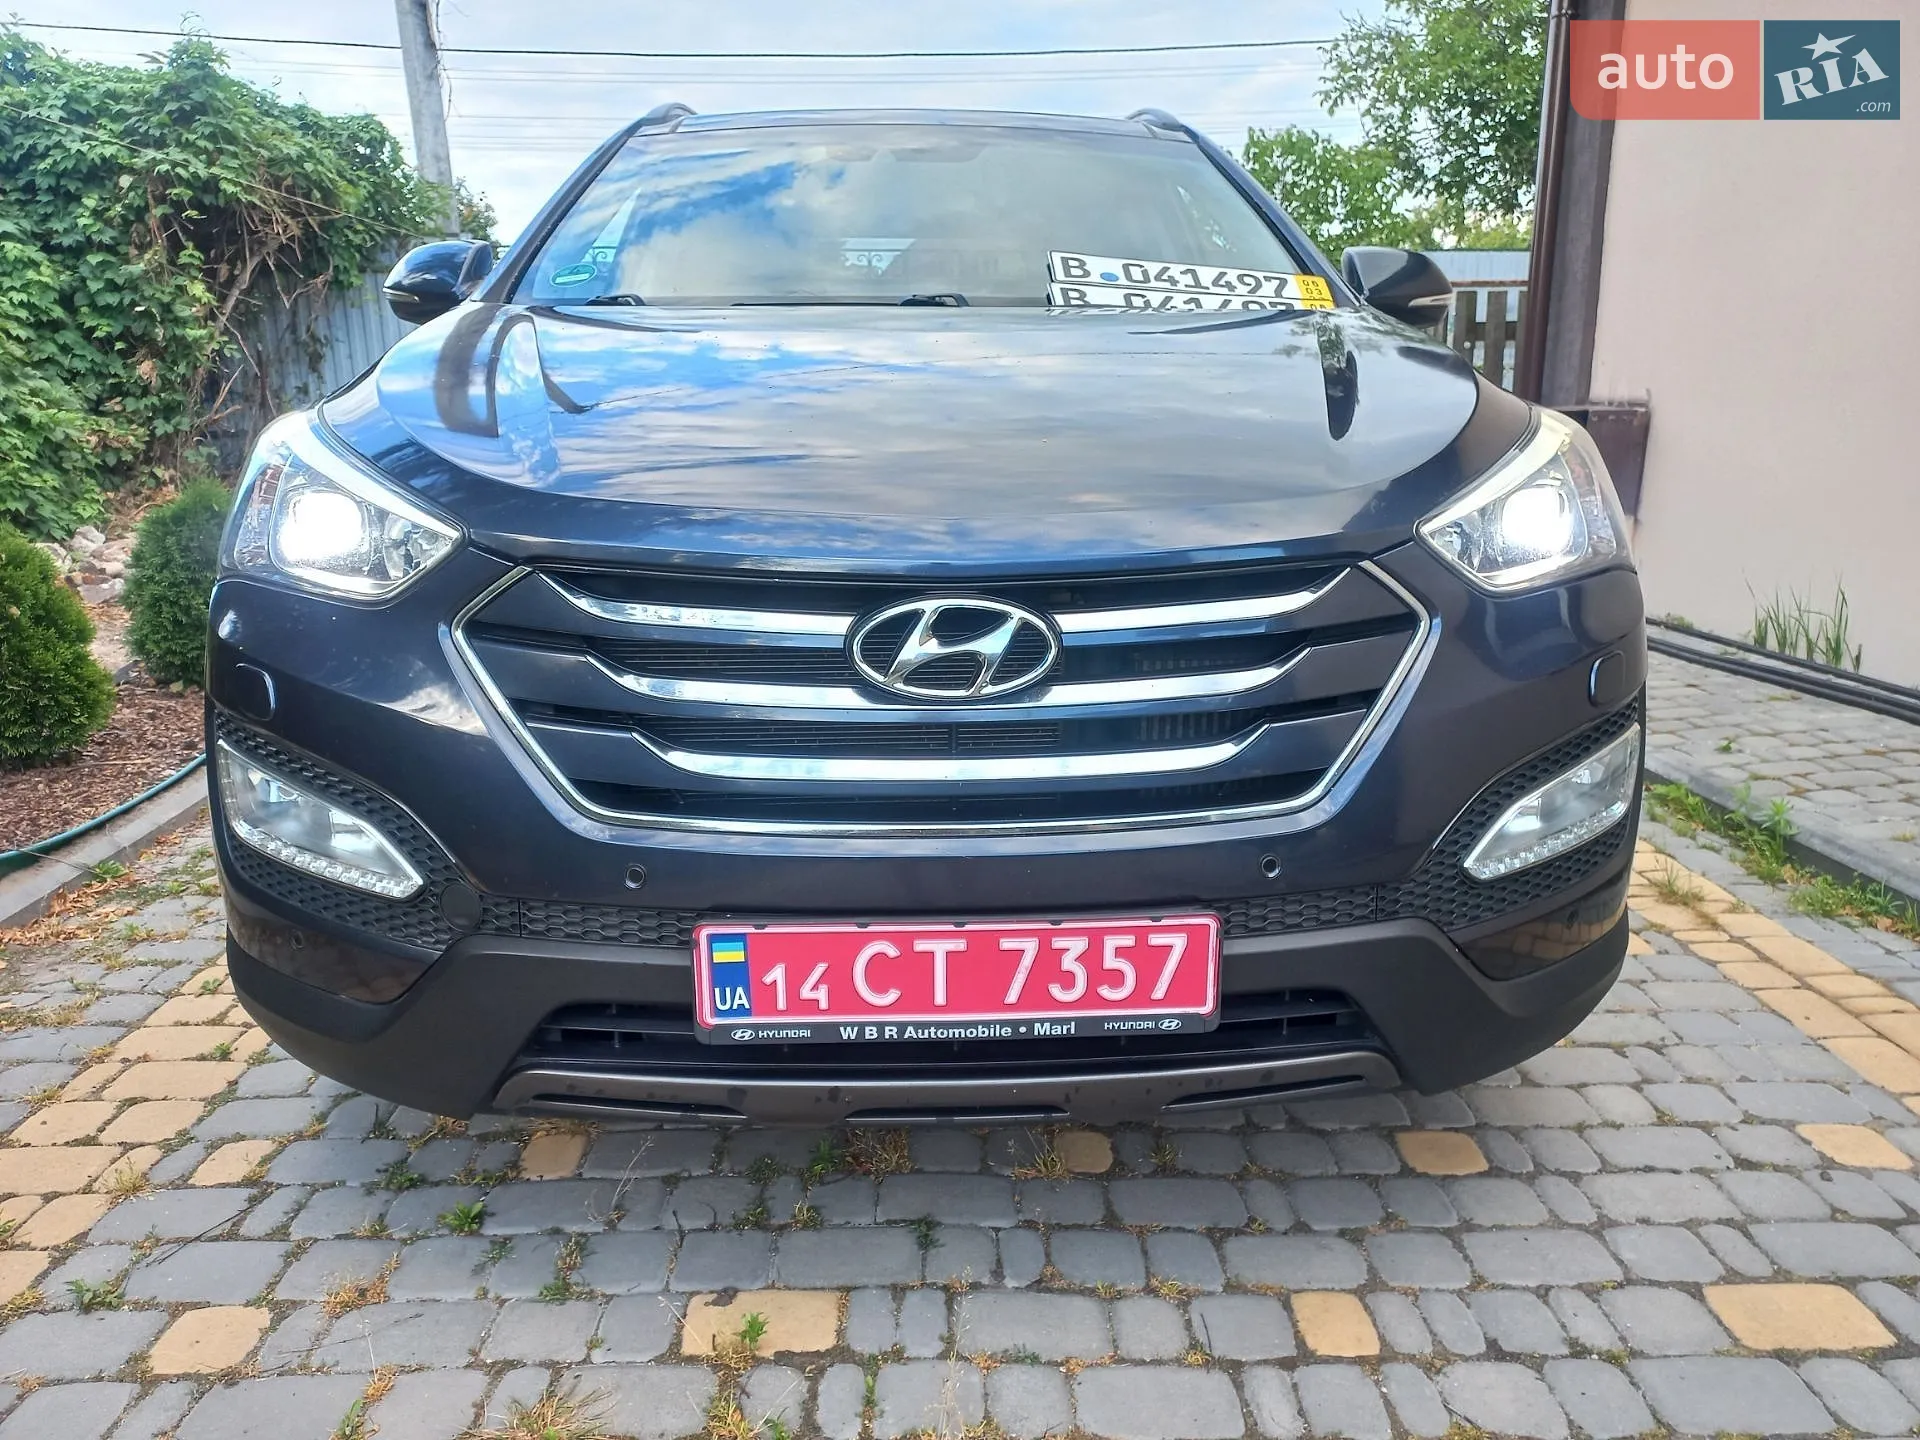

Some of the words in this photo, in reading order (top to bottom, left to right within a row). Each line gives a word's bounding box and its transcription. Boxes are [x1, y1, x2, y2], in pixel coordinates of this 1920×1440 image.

[1060, 256, 1092, 280] B
[1122, 262, 1289, 299] 041497
[761, 962, 830, 1011] 14
[851, 940, 968, 1008] CT
[999, 933, 1189, 1006] 7357
[713, 985, 751, 1011] UA
[757, 1028, 812, 1039] HYUNDAI
[839, 1026, 861, 1041] W
[865, 1026, 880, 1040] B
[884, 1025, 899, 1040] R
[903, 1022, 1012, 1039] Automobile
[1034, 1020, 1076, 1035] Marl
[1104, 1020, 1156, 1032] HYUNDAI
